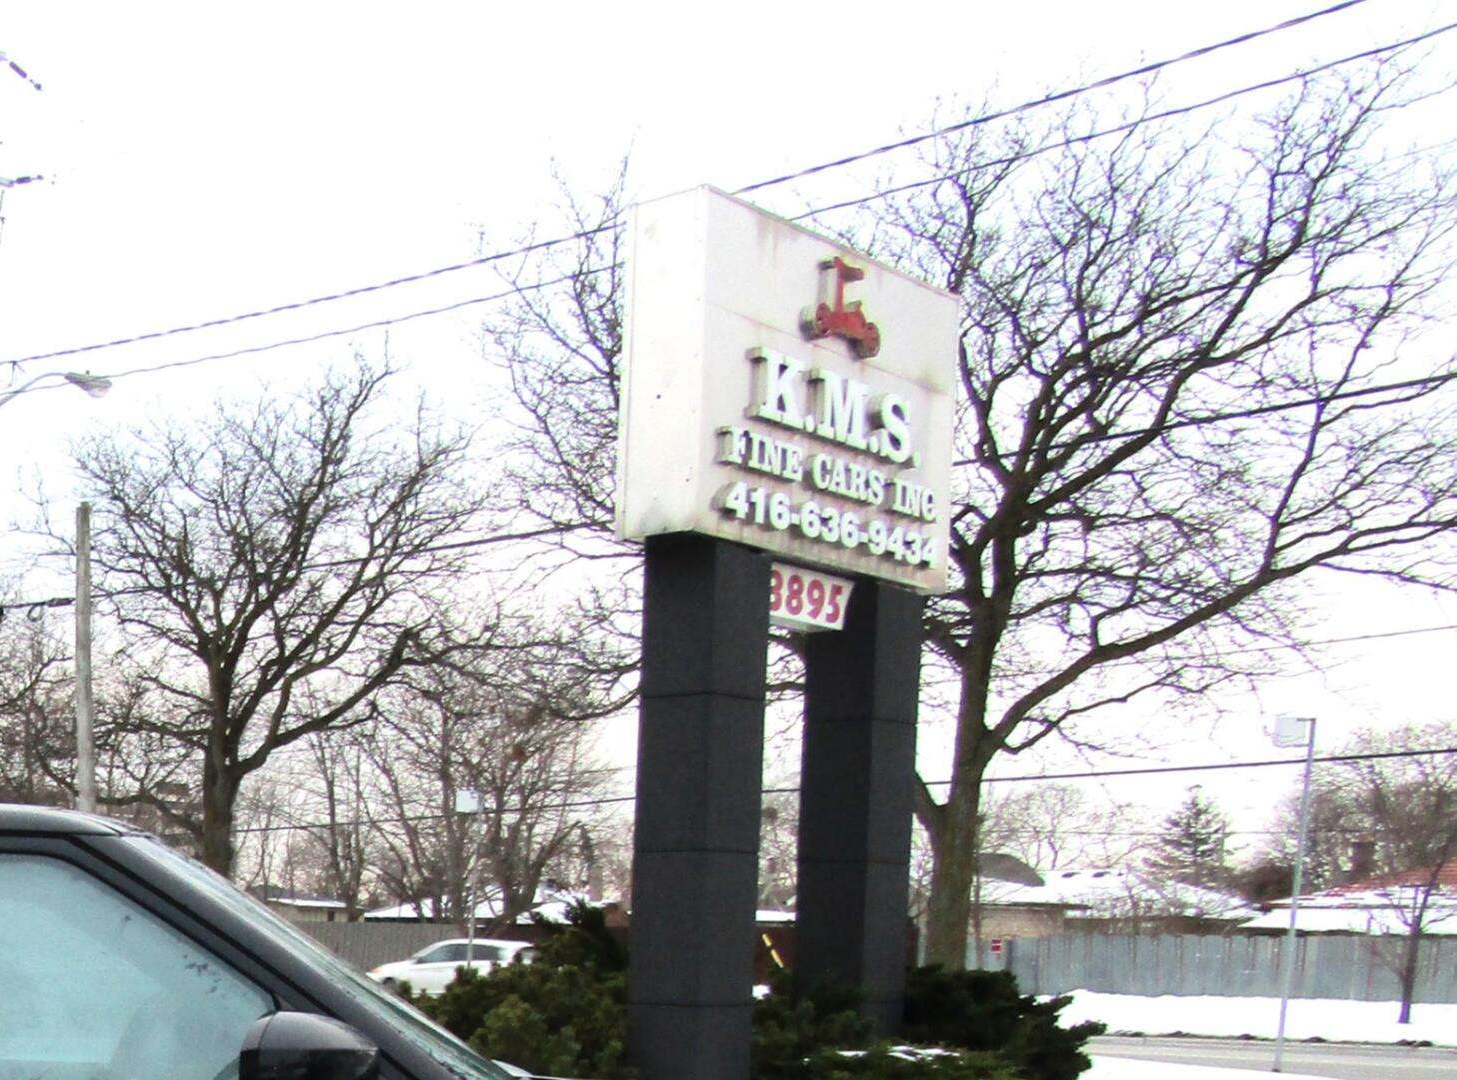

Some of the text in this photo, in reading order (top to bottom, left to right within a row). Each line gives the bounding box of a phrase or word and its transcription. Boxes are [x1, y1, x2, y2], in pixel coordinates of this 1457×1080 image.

[716, 426, 803, 481] FINE
[810, 454, 885, 506] CARS
[720, 481, 937, 569] 416-636-9434
